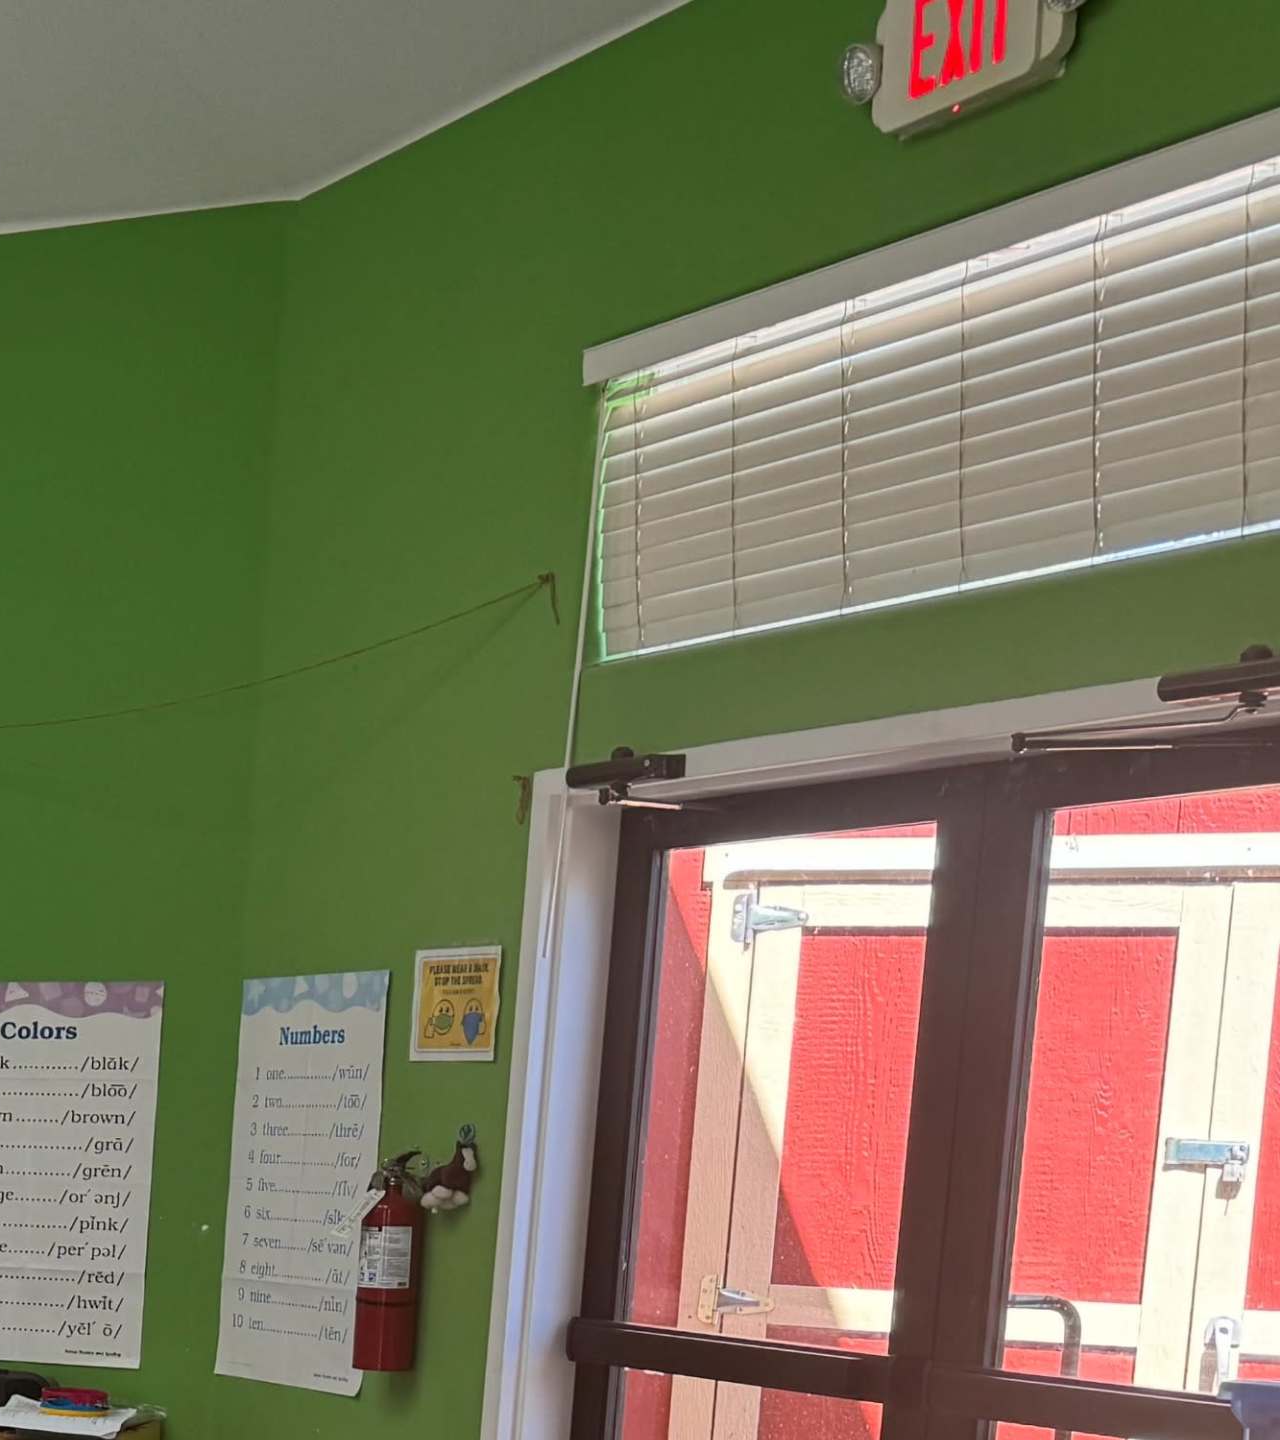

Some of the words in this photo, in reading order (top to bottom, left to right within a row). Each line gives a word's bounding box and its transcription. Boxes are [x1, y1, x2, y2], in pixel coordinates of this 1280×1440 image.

[0, 1021, 78, 1040] Colors
[279, 1024, 345, 1046] Numbers
[255, 1066, 260, 1081] 1
[266, 1067, 284, 1081] one
[252, 1094, 259, 1108] 2
[264, 1096, 282, 1109] two
[250, 1122, 257, 1136] 3
[262, 1122, 288, 1136] three
[244, 1205, 251, 1219] 6
[242, 1232, 249, 1245] 7
[254, 1237, 281, 1249] seven
[240, 1260, 246, 1273] 8
[250, 1262, 275, 1279] eight
[238, 1287, 245, 1301] 9
[232, 1313, 244, 1328] 10
[248, 1316, 264, 1330] ten
